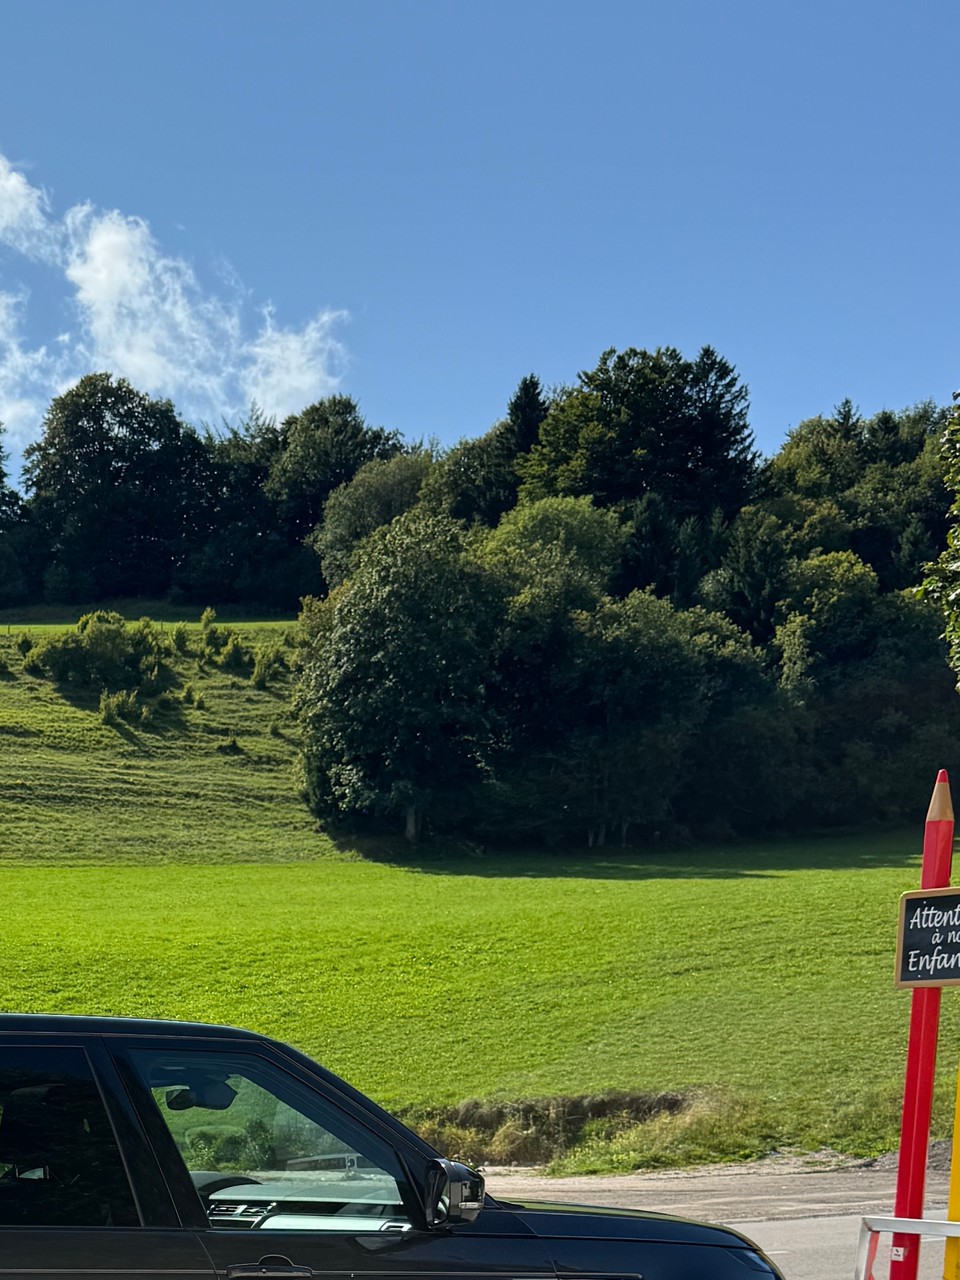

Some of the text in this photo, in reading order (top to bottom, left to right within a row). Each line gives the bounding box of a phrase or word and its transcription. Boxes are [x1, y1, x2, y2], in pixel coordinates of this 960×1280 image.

[909, 904, 960, 929] Attent
[931, 928, 944, 944] à
[908, 946, 960, 975] Enfan
